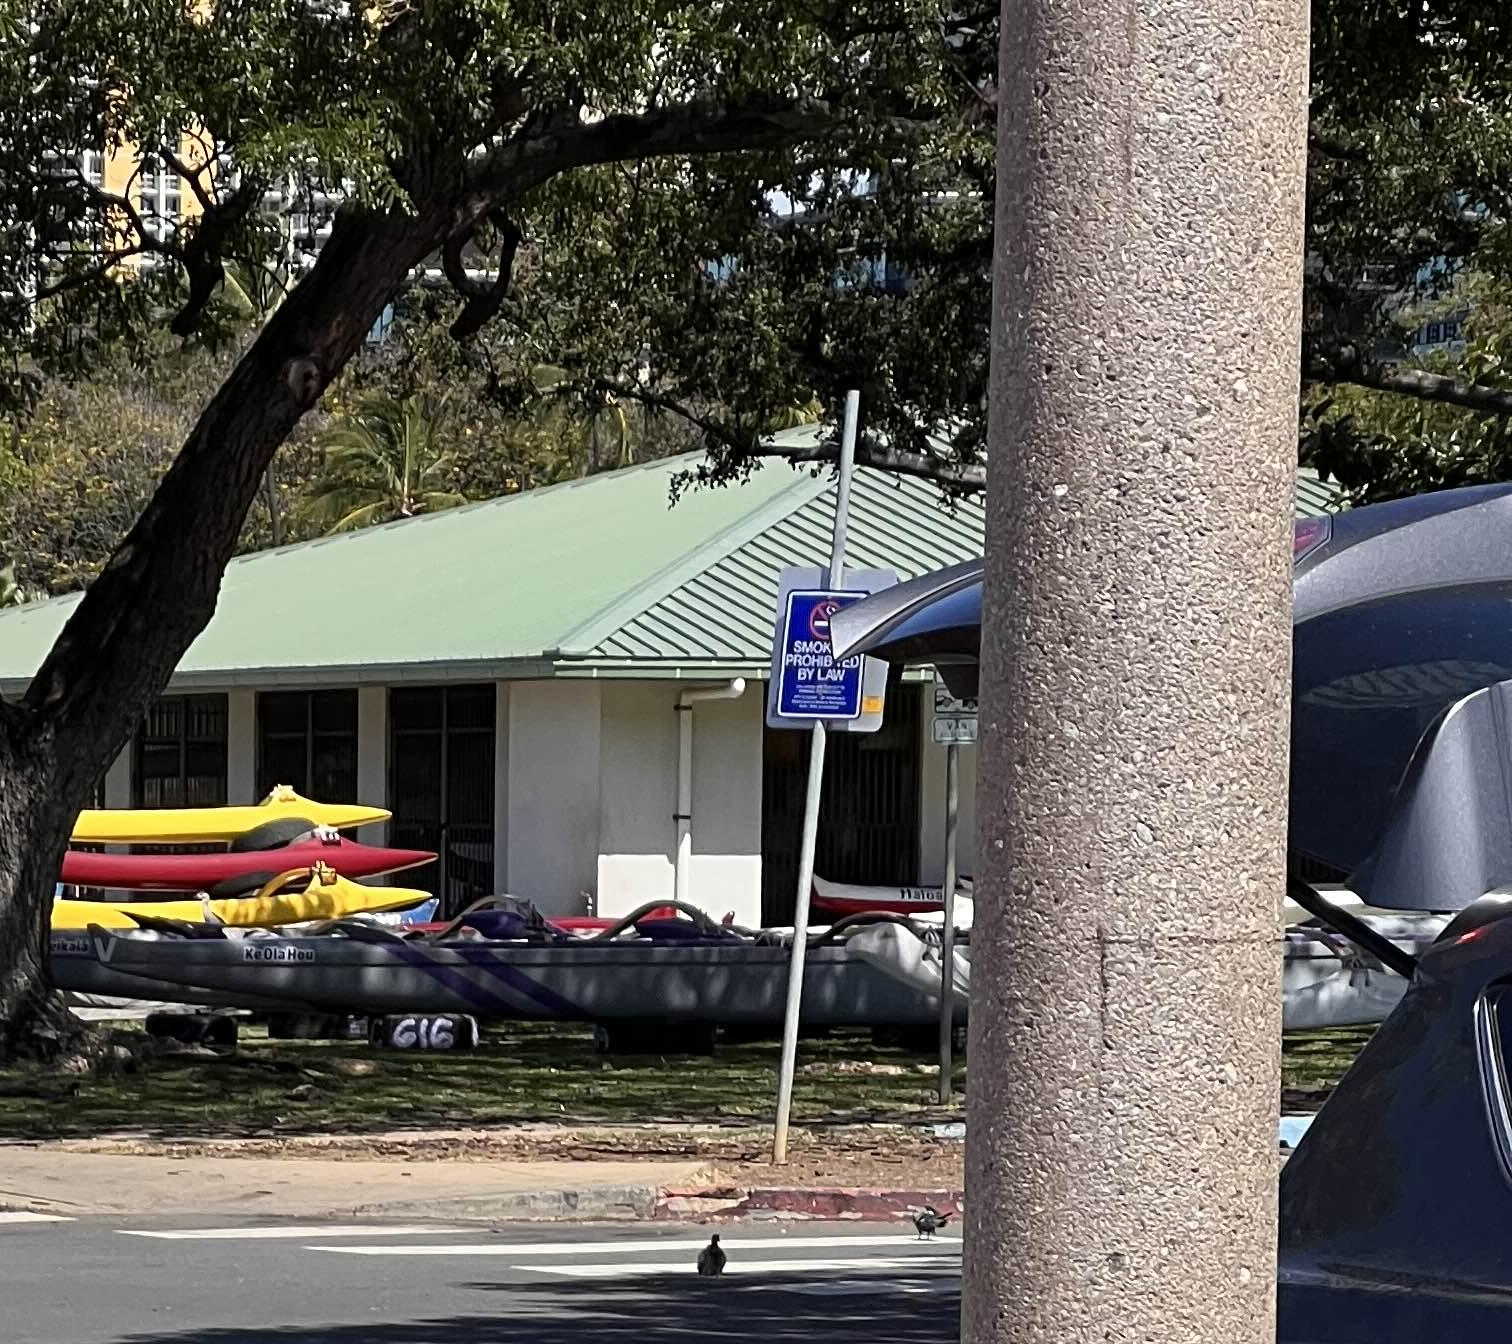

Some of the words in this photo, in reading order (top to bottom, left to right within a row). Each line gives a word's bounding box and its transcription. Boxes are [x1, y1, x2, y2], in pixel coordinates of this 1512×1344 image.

[793, 640, 831, 653] SMOK
[797, 668, 815, 680] BY
[817, 668, 846, 681] LAW
[94, 937, 117, 962] V
